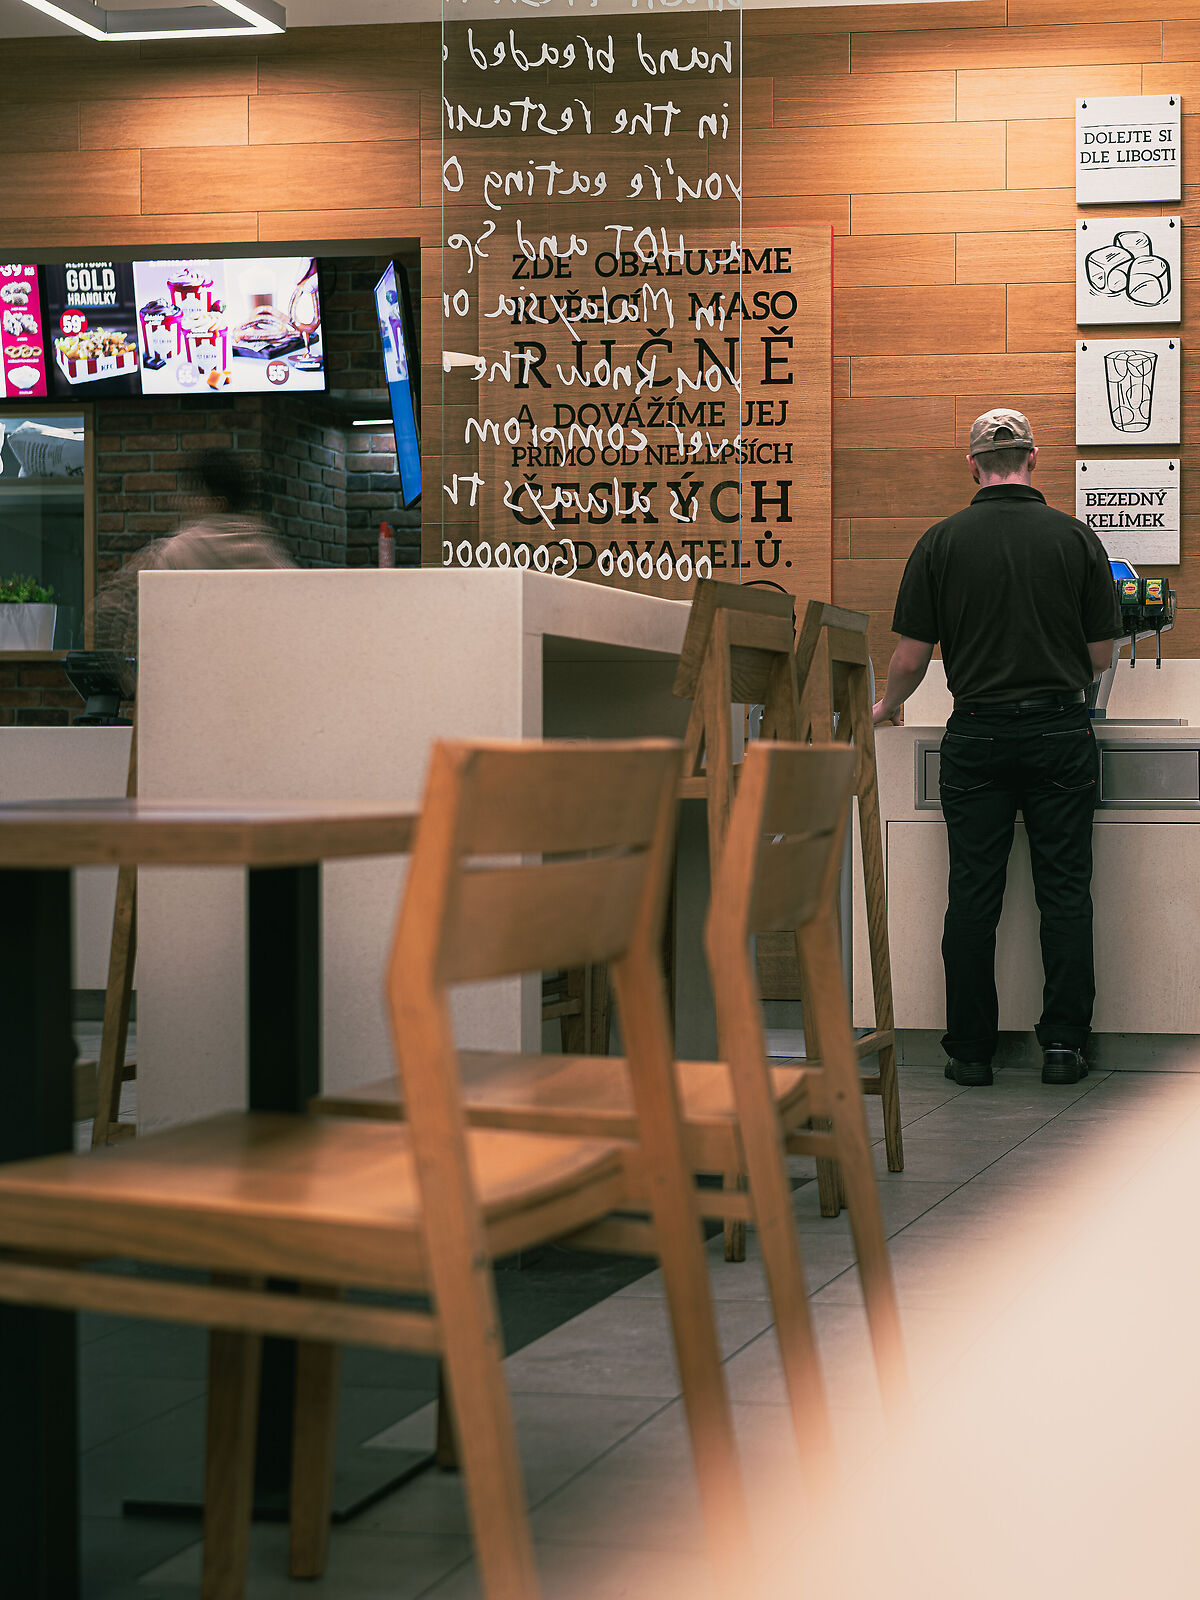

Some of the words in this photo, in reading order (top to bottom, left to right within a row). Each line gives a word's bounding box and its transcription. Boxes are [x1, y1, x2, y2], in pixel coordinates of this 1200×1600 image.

[1083, 130, 1152, 145] DOLEJTE
[1158, 129, 1173, 143] SI
[1080, 150, 1110, 164] DLE
[1116, 148, 1177, 163] LIBOSTI
[511, 253, 573, 280] ZDE
[595, 247, 792, 277] OBALUJEME
[66, 269, 116, 292] GOLD
[67, 291, 117, 306] HRANOLKY
[688, 290, 798, 322] MASO
[513, 326, 794, 389] RUČNĚ
[516, 404, 536, 430] A
[553, 396, 726, 428] DOVÁŽÍME
[741, 399, 789, 427] JEJ
[511, 442, 596, 468] PŘÍMO
[601, 444, 639, 467] OD
[645, 438, 794, 465] NEJLEPŠÍCH
[512, 472, 793, 525] ČESKÝCH
[1085, 490, 1168, 508] BEZEDNÝ
[1084, 511, 1165, 529] KELÍMEK
[511, 530, 793, 569] DODAVATELŮ.
